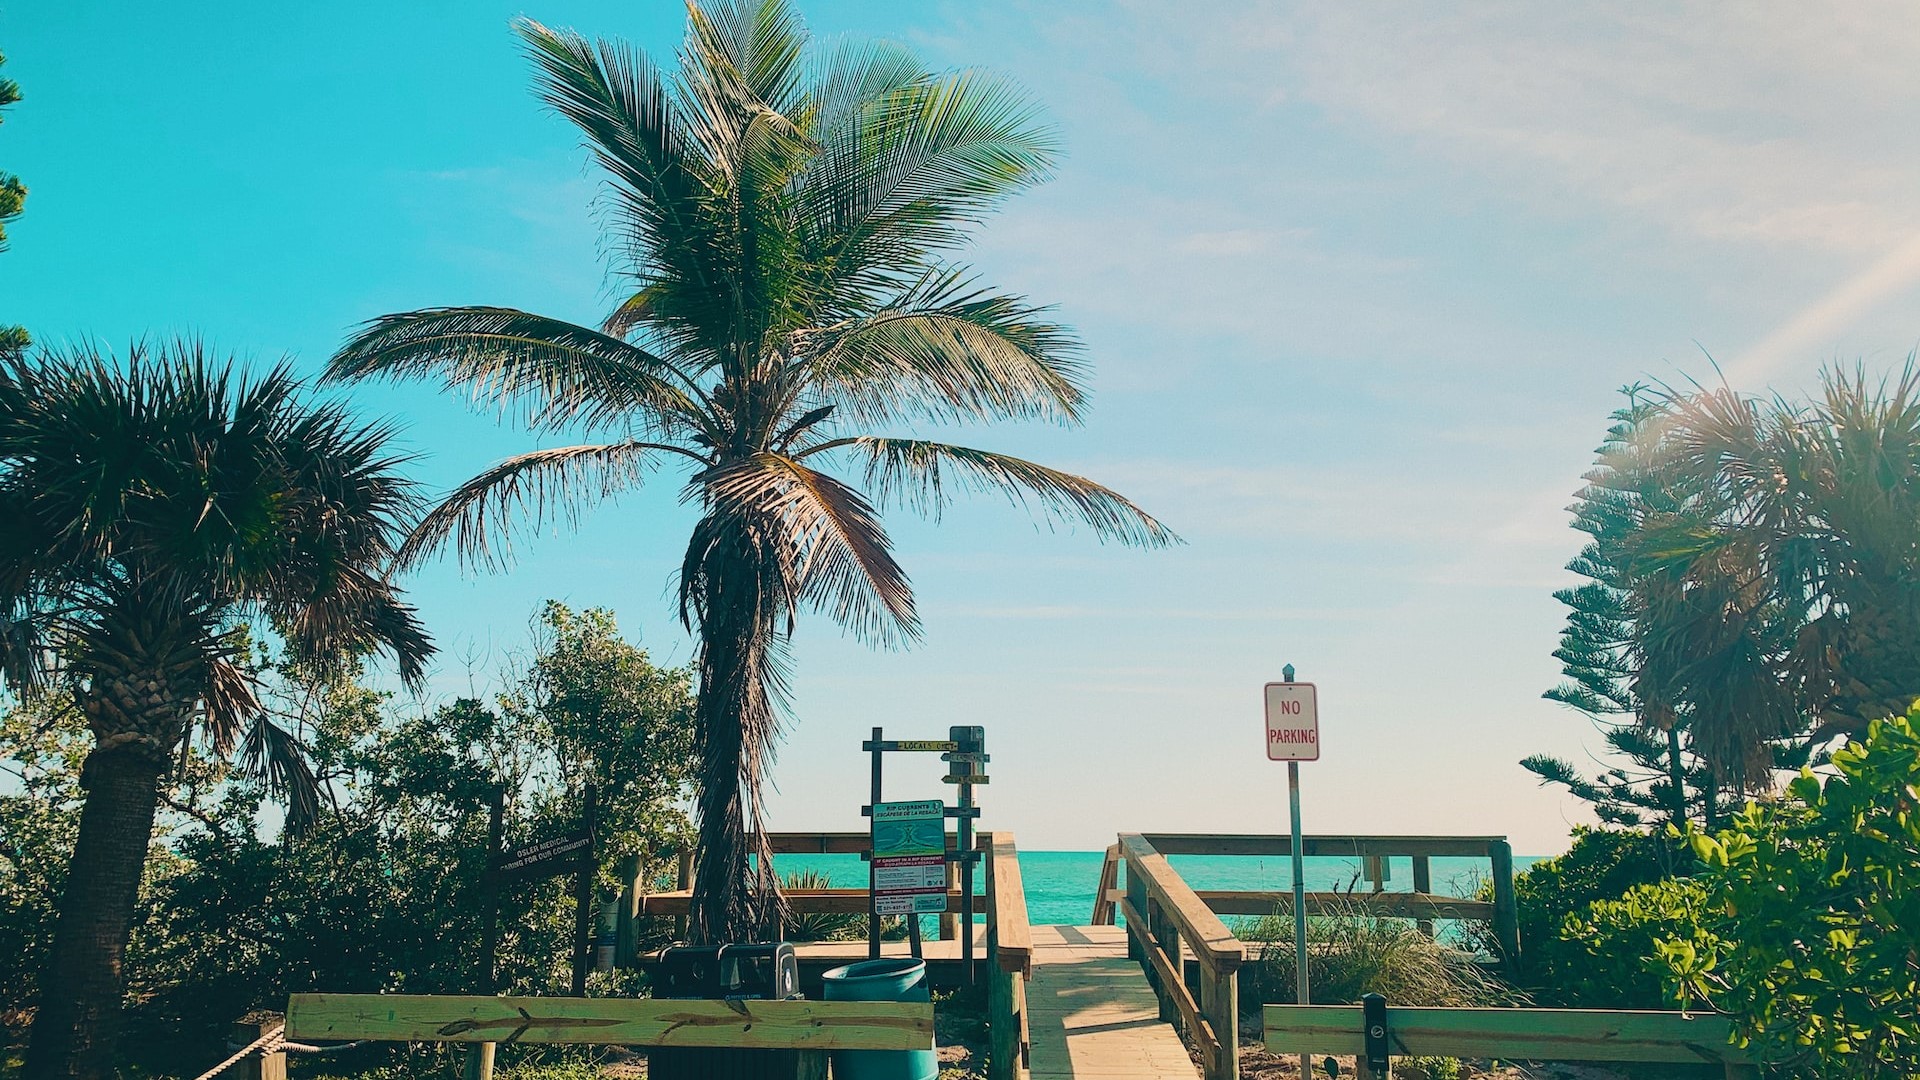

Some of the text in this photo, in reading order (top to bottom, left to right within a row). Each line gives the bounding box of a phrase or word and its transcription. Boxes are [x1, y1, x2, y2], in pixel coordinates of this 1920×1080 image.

[1281, 700, 1301, 715] NO
[1270, 729, 1315, 744] PARKING
[904, 742, 932, 750] LOCALS
[516, 836, 570, 858] OSLER MEDICAL
[525, 855, 538, 865] FOR
[538, 850, 553, 860] OUR
[552, 838, 590, 855] COMMUNITY
